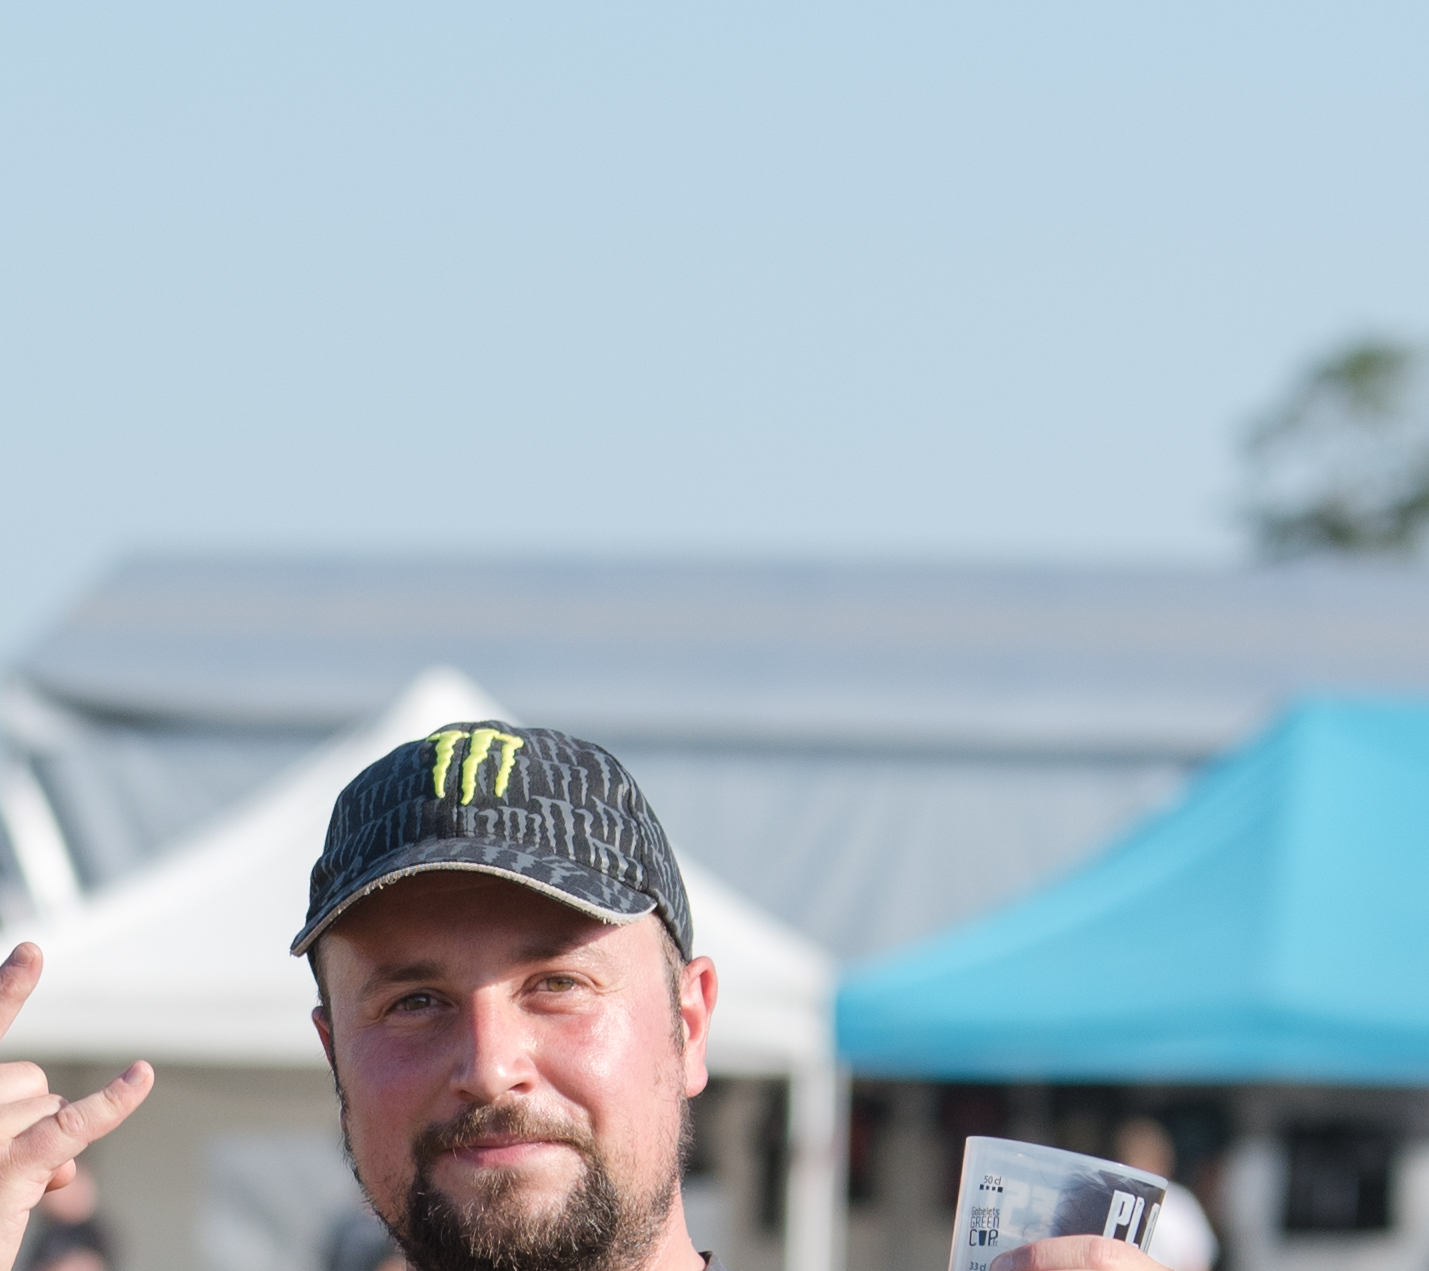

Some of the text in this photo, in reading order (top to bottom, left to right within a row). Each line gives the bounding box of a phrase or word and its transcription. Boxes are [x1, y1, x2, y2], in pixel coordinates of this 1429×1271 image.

[984, 1175, 1002, 1186] 50 cl
[969, 1261, 979, 1271] 33
